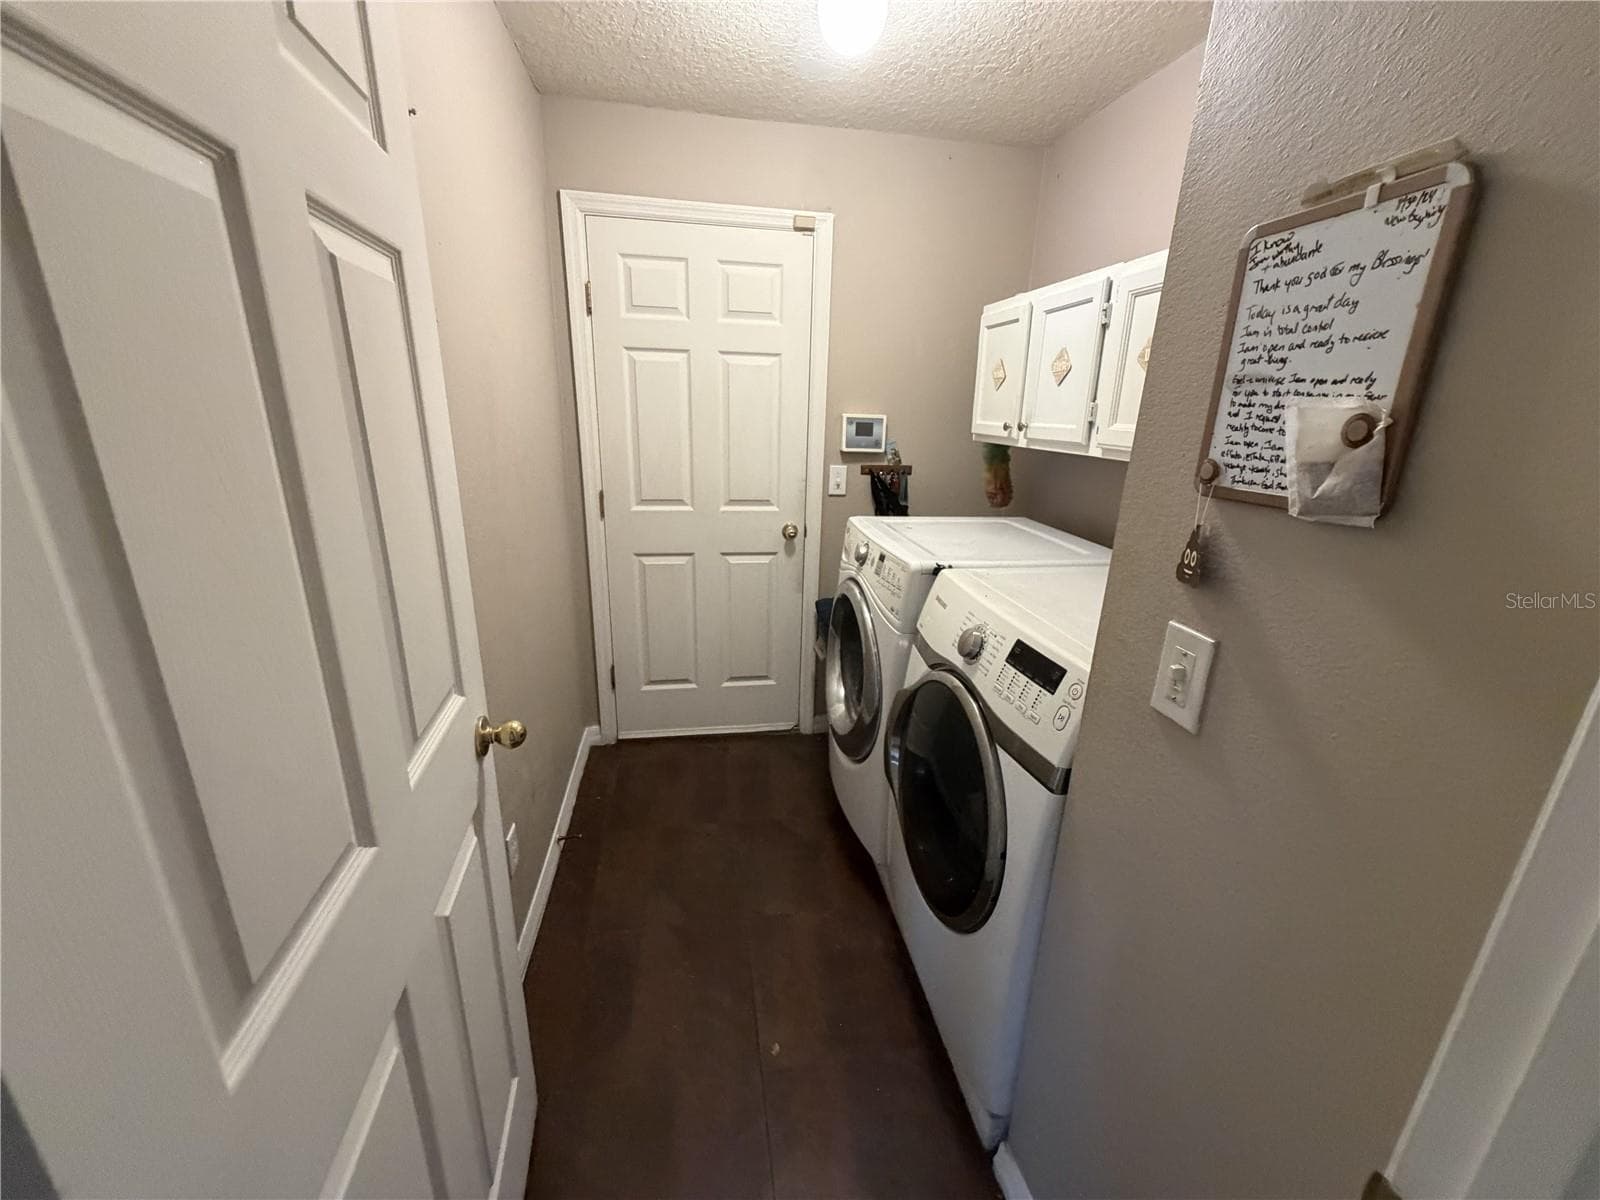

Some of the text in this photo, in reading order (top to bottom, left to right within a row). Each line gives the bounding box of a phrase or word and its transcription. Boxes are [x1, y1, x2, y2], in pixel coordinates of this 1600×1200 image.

[1253, 278, 1281, 295] Thank
[1284, 276, 1304, 293] you
[1348, 262, 1367, 288] my
[1246, 304, 1276, 326] Today
[1301, 294, 1334, 322] great
[1333, 291, 1360, 315] day
[1309, 334, 1336, 355] ready
[1338, 332, 1351, 345] to
